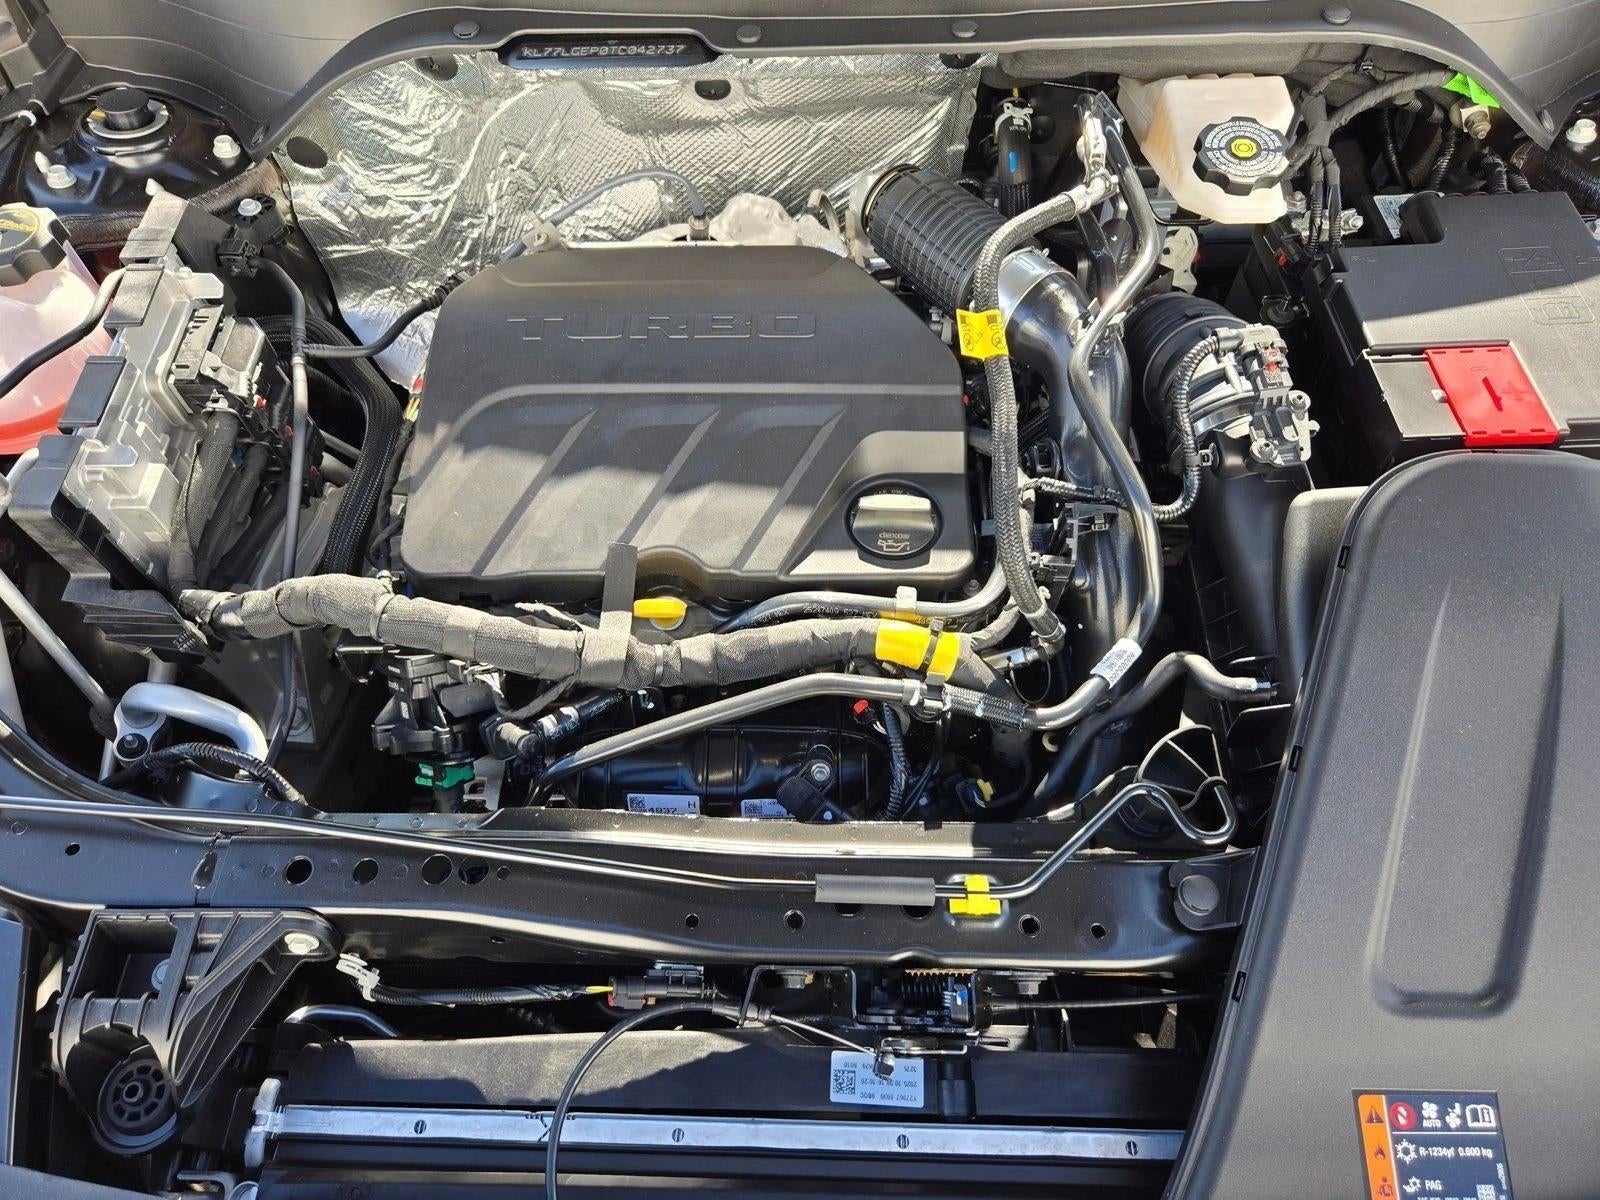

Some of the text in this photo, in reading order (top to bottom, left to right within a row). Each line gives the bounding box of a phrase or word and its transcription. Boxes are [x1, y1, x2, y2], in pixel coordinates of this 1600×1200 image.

[523, 45, 686, 57] KL77LGEP0TC042737
[507, 313, 816, 340] TURBO
[688, 801, 696, 809] H
[1422, 1119, 1441, 1128] AUTO
[1419, 1146, 1493, 1158] R-1234yf 0.600 kg
[1425, 1179, 1442, 1190] PAG
